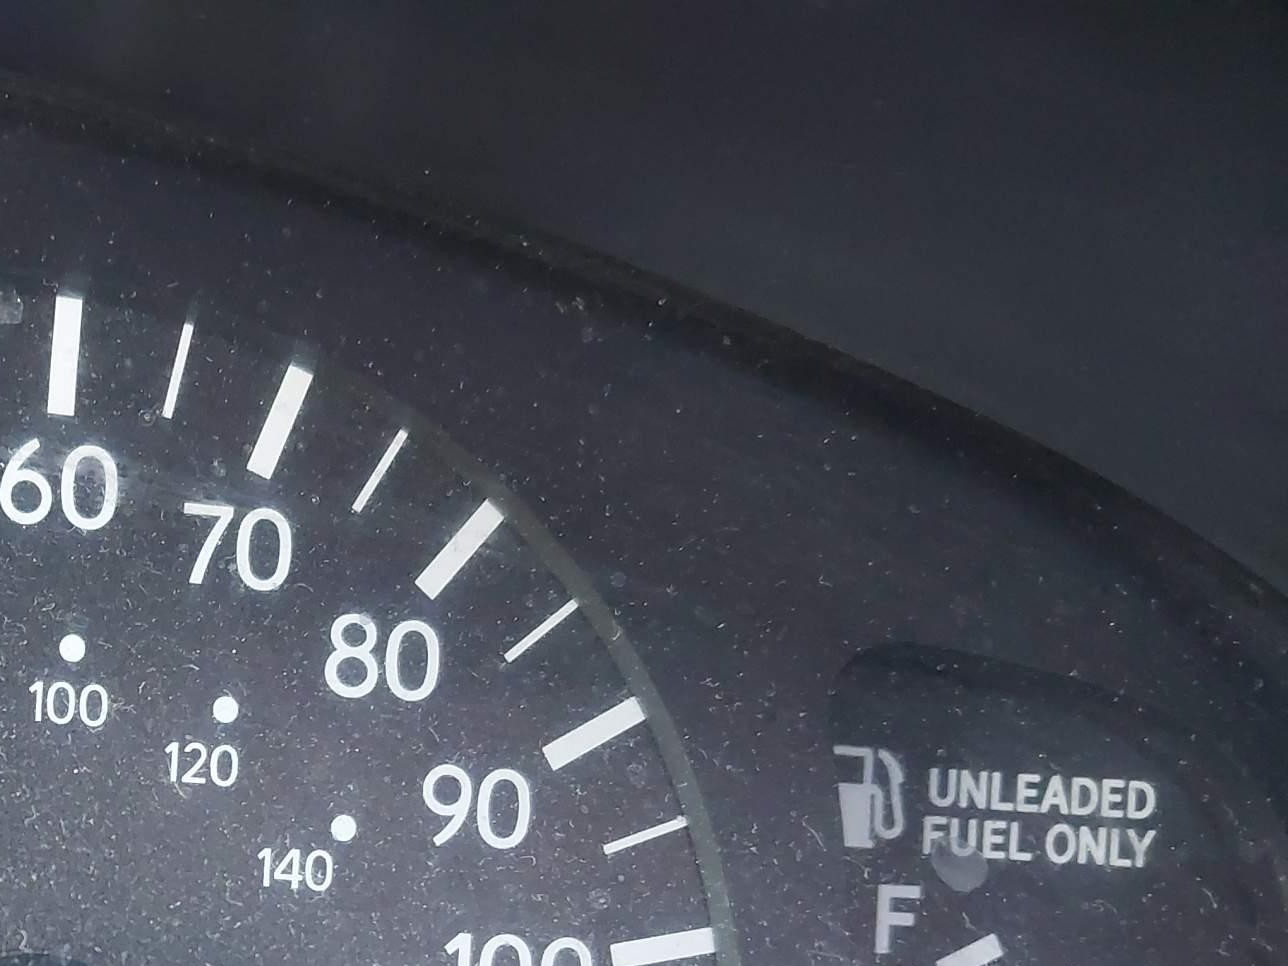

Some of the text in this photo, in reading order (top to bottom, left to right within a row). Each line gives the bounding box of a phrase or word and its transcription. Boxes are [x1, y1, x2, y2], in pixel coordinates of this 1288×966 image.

[0, 438, 118, 532] 60
[184, 502, 292, 591] 70
[325, 613, 440, 701] 80
[29, 681, 109, 727] 100
[165, 742, 238, 787] 120
[926, 767, 1157, 821] UNLEADED
[423, 764, 531, 849] 90
[258, 848, 329, 891] 140
[922, 816, 1156, 867] FUEL ONLY
[875, 884, 922, 954] F
